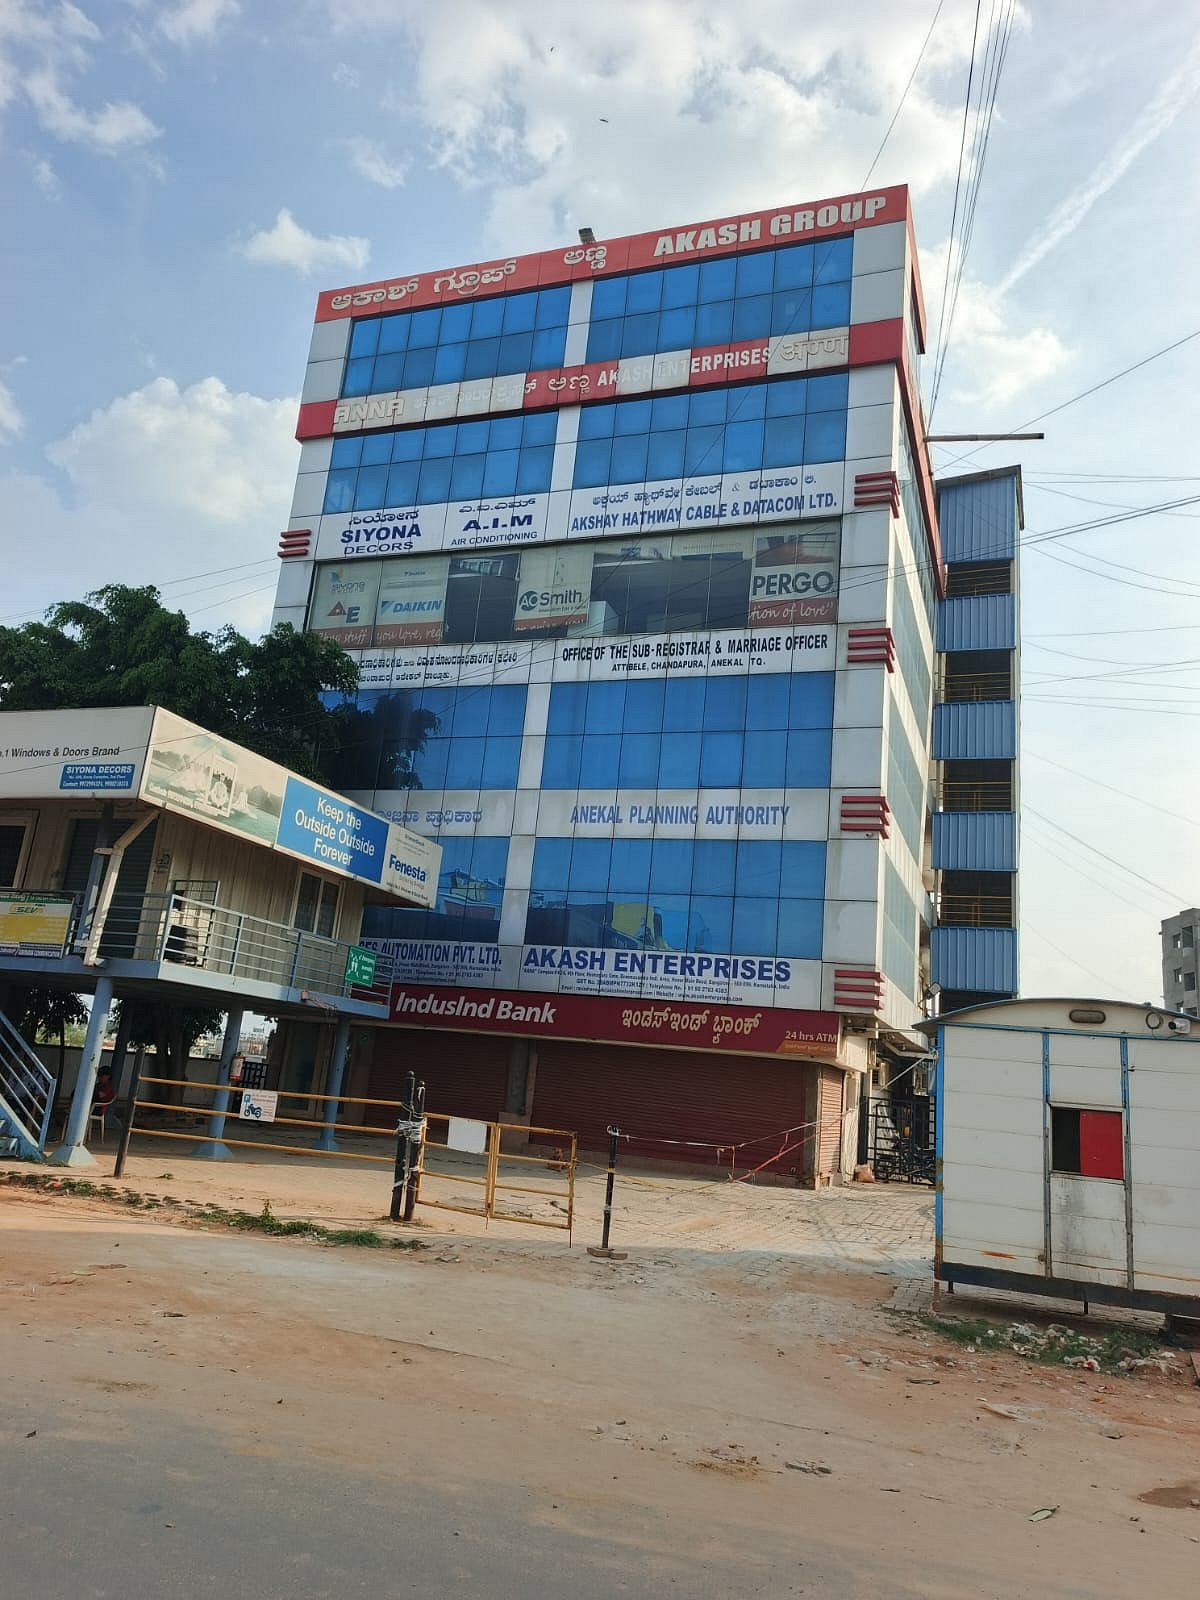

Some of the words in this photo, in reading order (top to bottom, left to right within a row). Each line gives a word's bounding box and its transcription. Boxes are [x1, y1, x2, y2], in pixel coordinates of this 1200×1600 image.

[653, 219, 761, 257] AKASH
[769, 196, 886, 236] GROUP
[571, 512, 620, 531] AKSHAY
[622, 507, 681, 527] HATHWAY
[686, 502, 727, 521] CABLE
[731, 503, 740, 516] &
[743, 495, 805, 515] DATACOM
[809, 492, 837, 509] LTD.
[462, 514, 533, 531] A.I.M
[340, 523, 422, 543] SIYONA
[451, 538, 467, 546] AIR
[469, 531, 538, 544] CONDITIONING
[344, 541, 414, 555] DECORS
[752, 571, 834, 596] PERGO
[392, 600, 442, 613] DAIKIN
[540, 589, 582, 606] Smith
[783, 603, 797, 623] of
[562, 646, 593, 662] OFFICE
[594, 646, 606, 661] OF
[610, 644, 628, 660] THE
[715, 641, 722, 654] &
[727, 636, 782, 653] MARRIAGE
[785, 634, 828, 650] OFFICER
[611, 662, 649, 672] ATTIBELE,
[651, 659, 707, 670] CHANDAPURA,
[711, 658, 744, 668] ANEKAL
[11, 747, 51, 757] Windows
[53, 746, 60, 757] &
[62, 746, 89, 757] Doors
[92, 746, 120, 757] Brand
[66, 766, 97, 774] SIYONA
[99, 765, 132, 774] DECORS
[317, 796, 345, 823] Keep
[345, 809, 362, 831] the
[570, 805, 623, 824] ANEKAL
[629, 805, 698, 824] PLANNING
[705, 805, 790, 825] AUTHORITY
[295, 808, 336, 840] Outside
[338, 829, 375, 857] Outside
[313, 837, 353, 866] Forever
[388, 853, 426, 882] Fenesta
[381, 941, 450, 962] AUTOMATION
[452, 945, 475, 964] PVT.
[479, 946, 502, 965] LTD.
[523, 947, 606, 972] AKASH
[613, 950, 792, 983] ENTERPRISES
[396, 992, 495, 1020] IndusInd
[496, 1000, 557, 1024] Bank
[785, 1030, 797, 1040] 24
[799, 1031, 814, 1041] hrs
[816, 1032, 837, 1043] ATM
